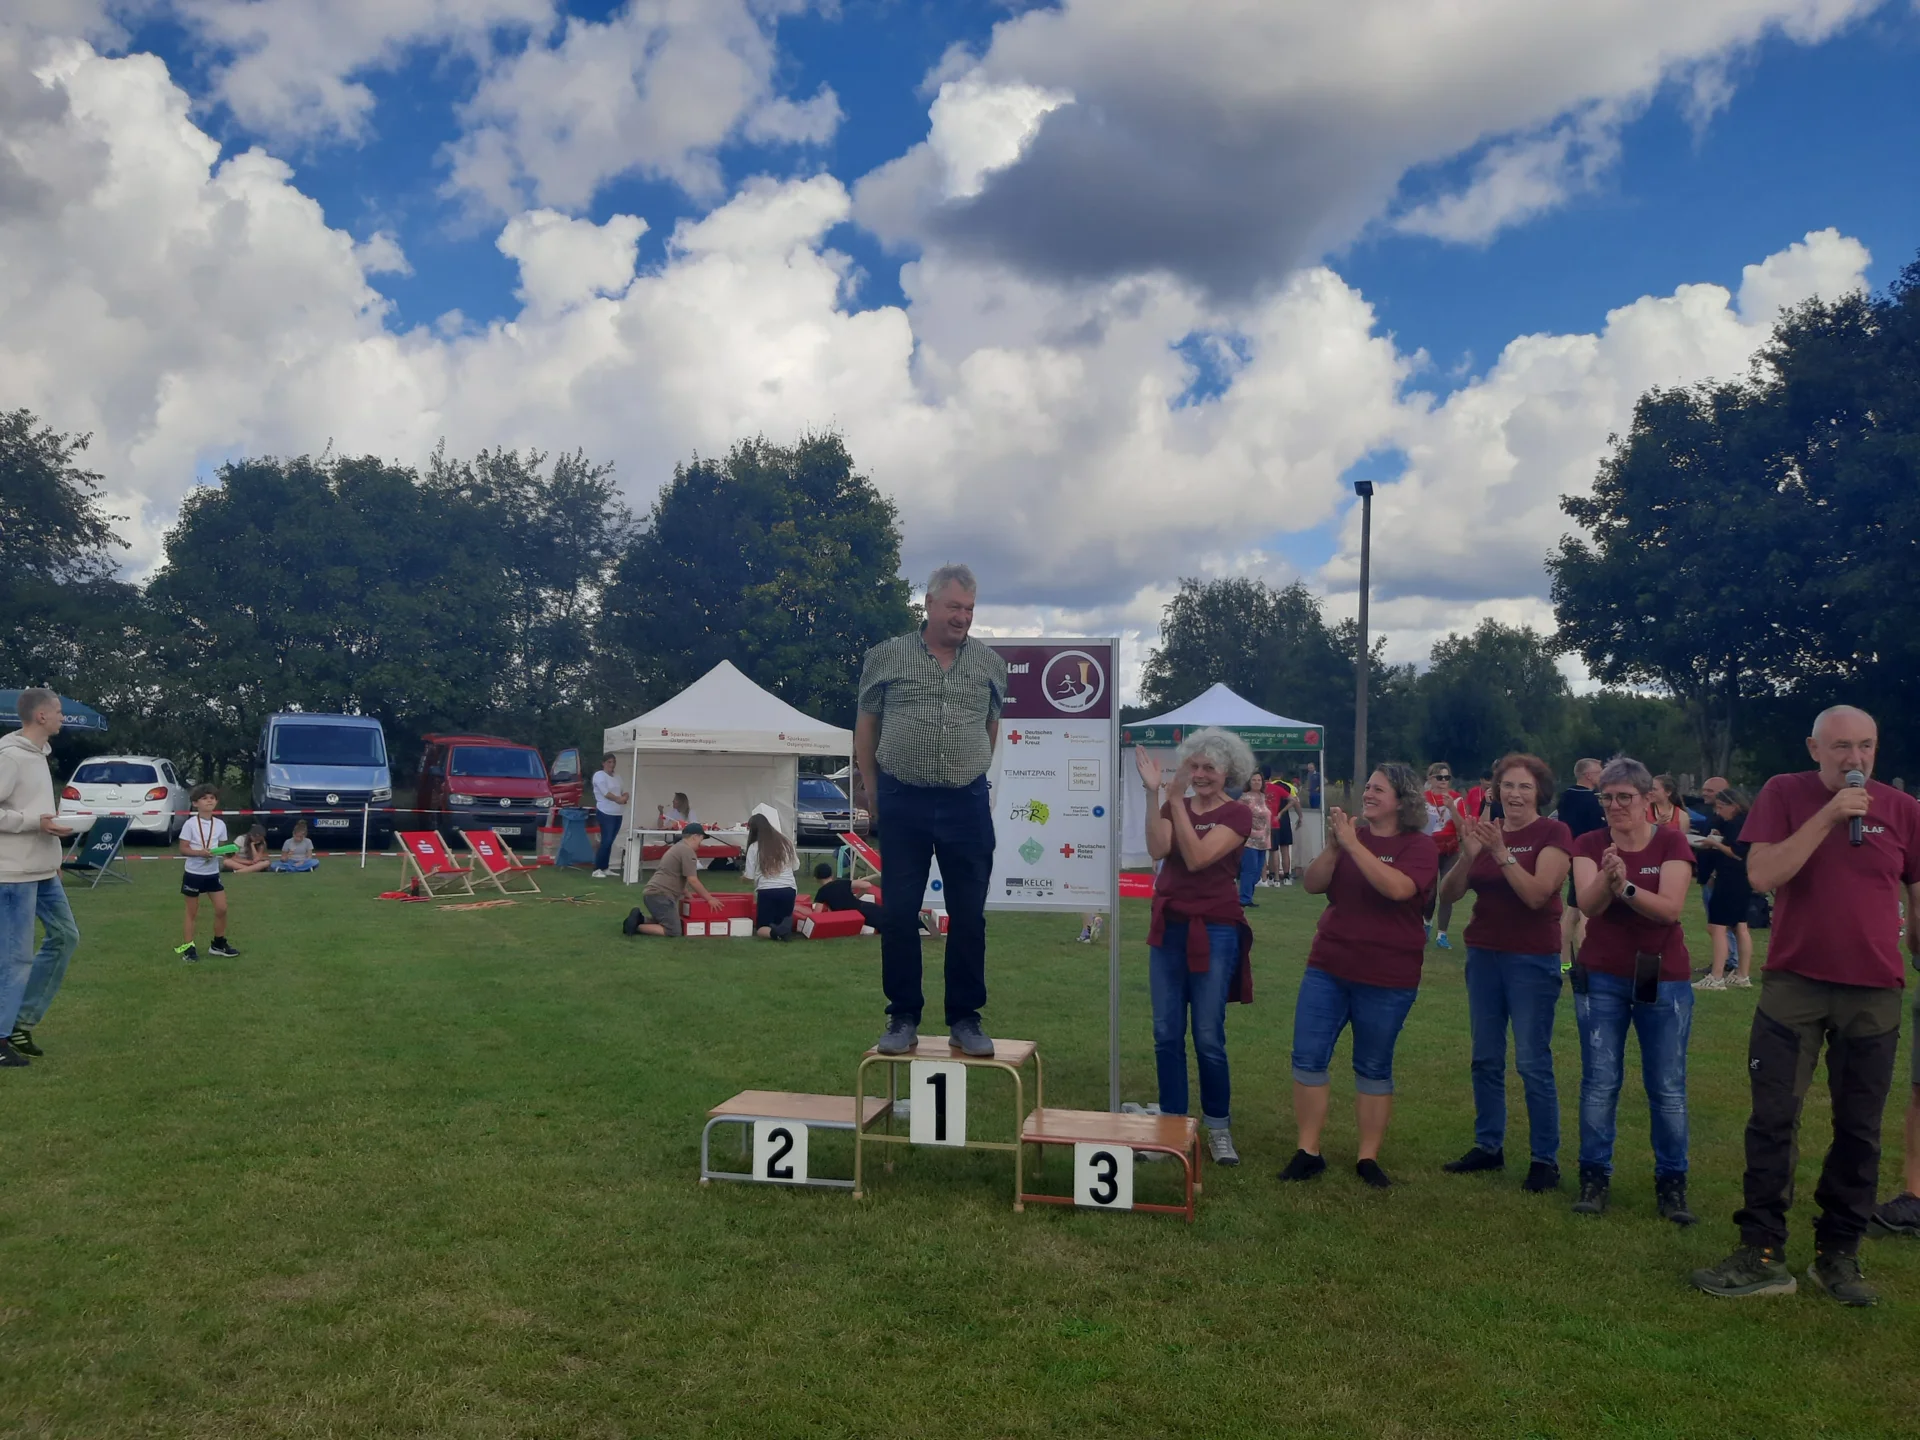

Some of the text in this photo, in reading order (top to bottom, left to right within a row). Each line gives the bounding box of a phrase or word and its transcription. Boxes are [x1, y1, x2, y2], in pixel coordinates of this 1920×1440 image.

[1007, 662, 1030, 674] Lauf
[92, 843, 114, 851] AOK
[1024, 879, 1053, 887] KELCH
[926, 1072, 947, 1141] 1
[767, 1127, 794, 1180] 2
[1089, 1151, 1119, 1204] 3
